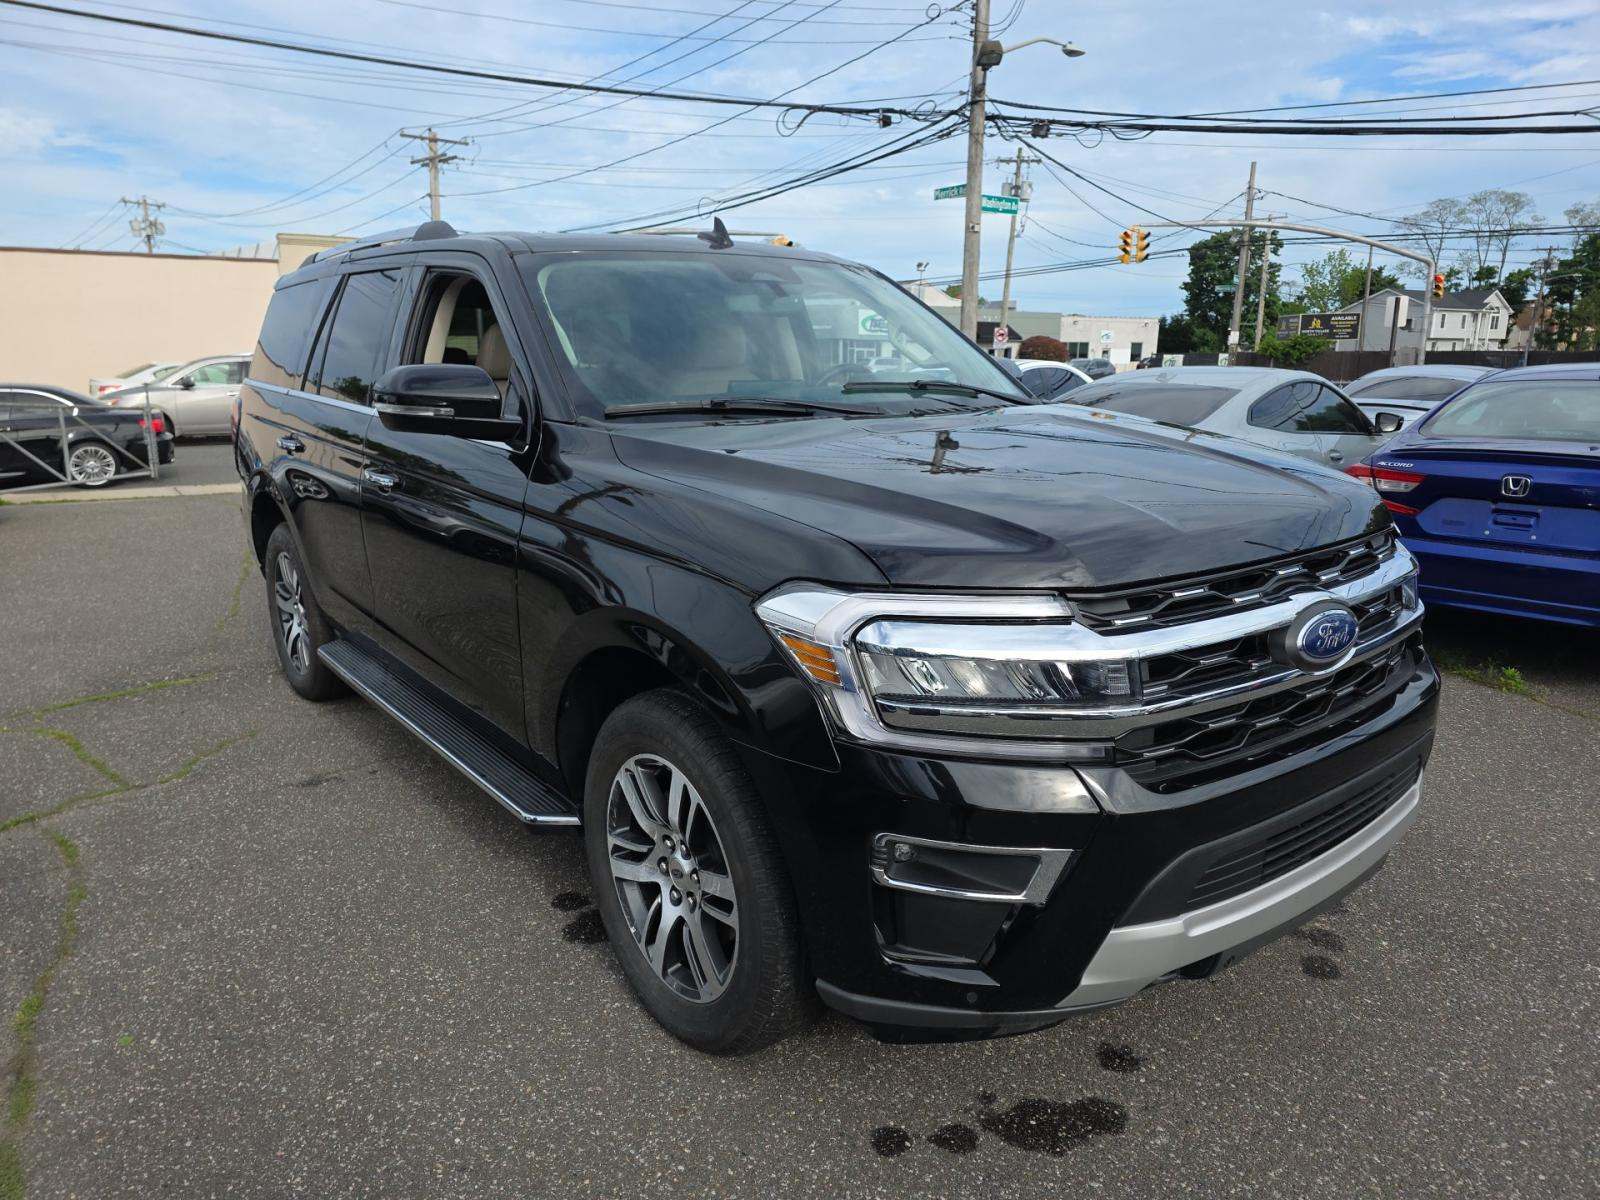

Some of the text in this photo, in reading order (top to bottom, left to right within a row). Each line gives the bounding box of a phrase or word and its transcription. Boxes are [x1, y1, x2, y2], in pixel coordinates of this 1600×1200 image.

[934, 187, 960, 200] Merrick
[982, 197, 1011, 211] Washington
[1317, 621, 1350, 649] Ford
